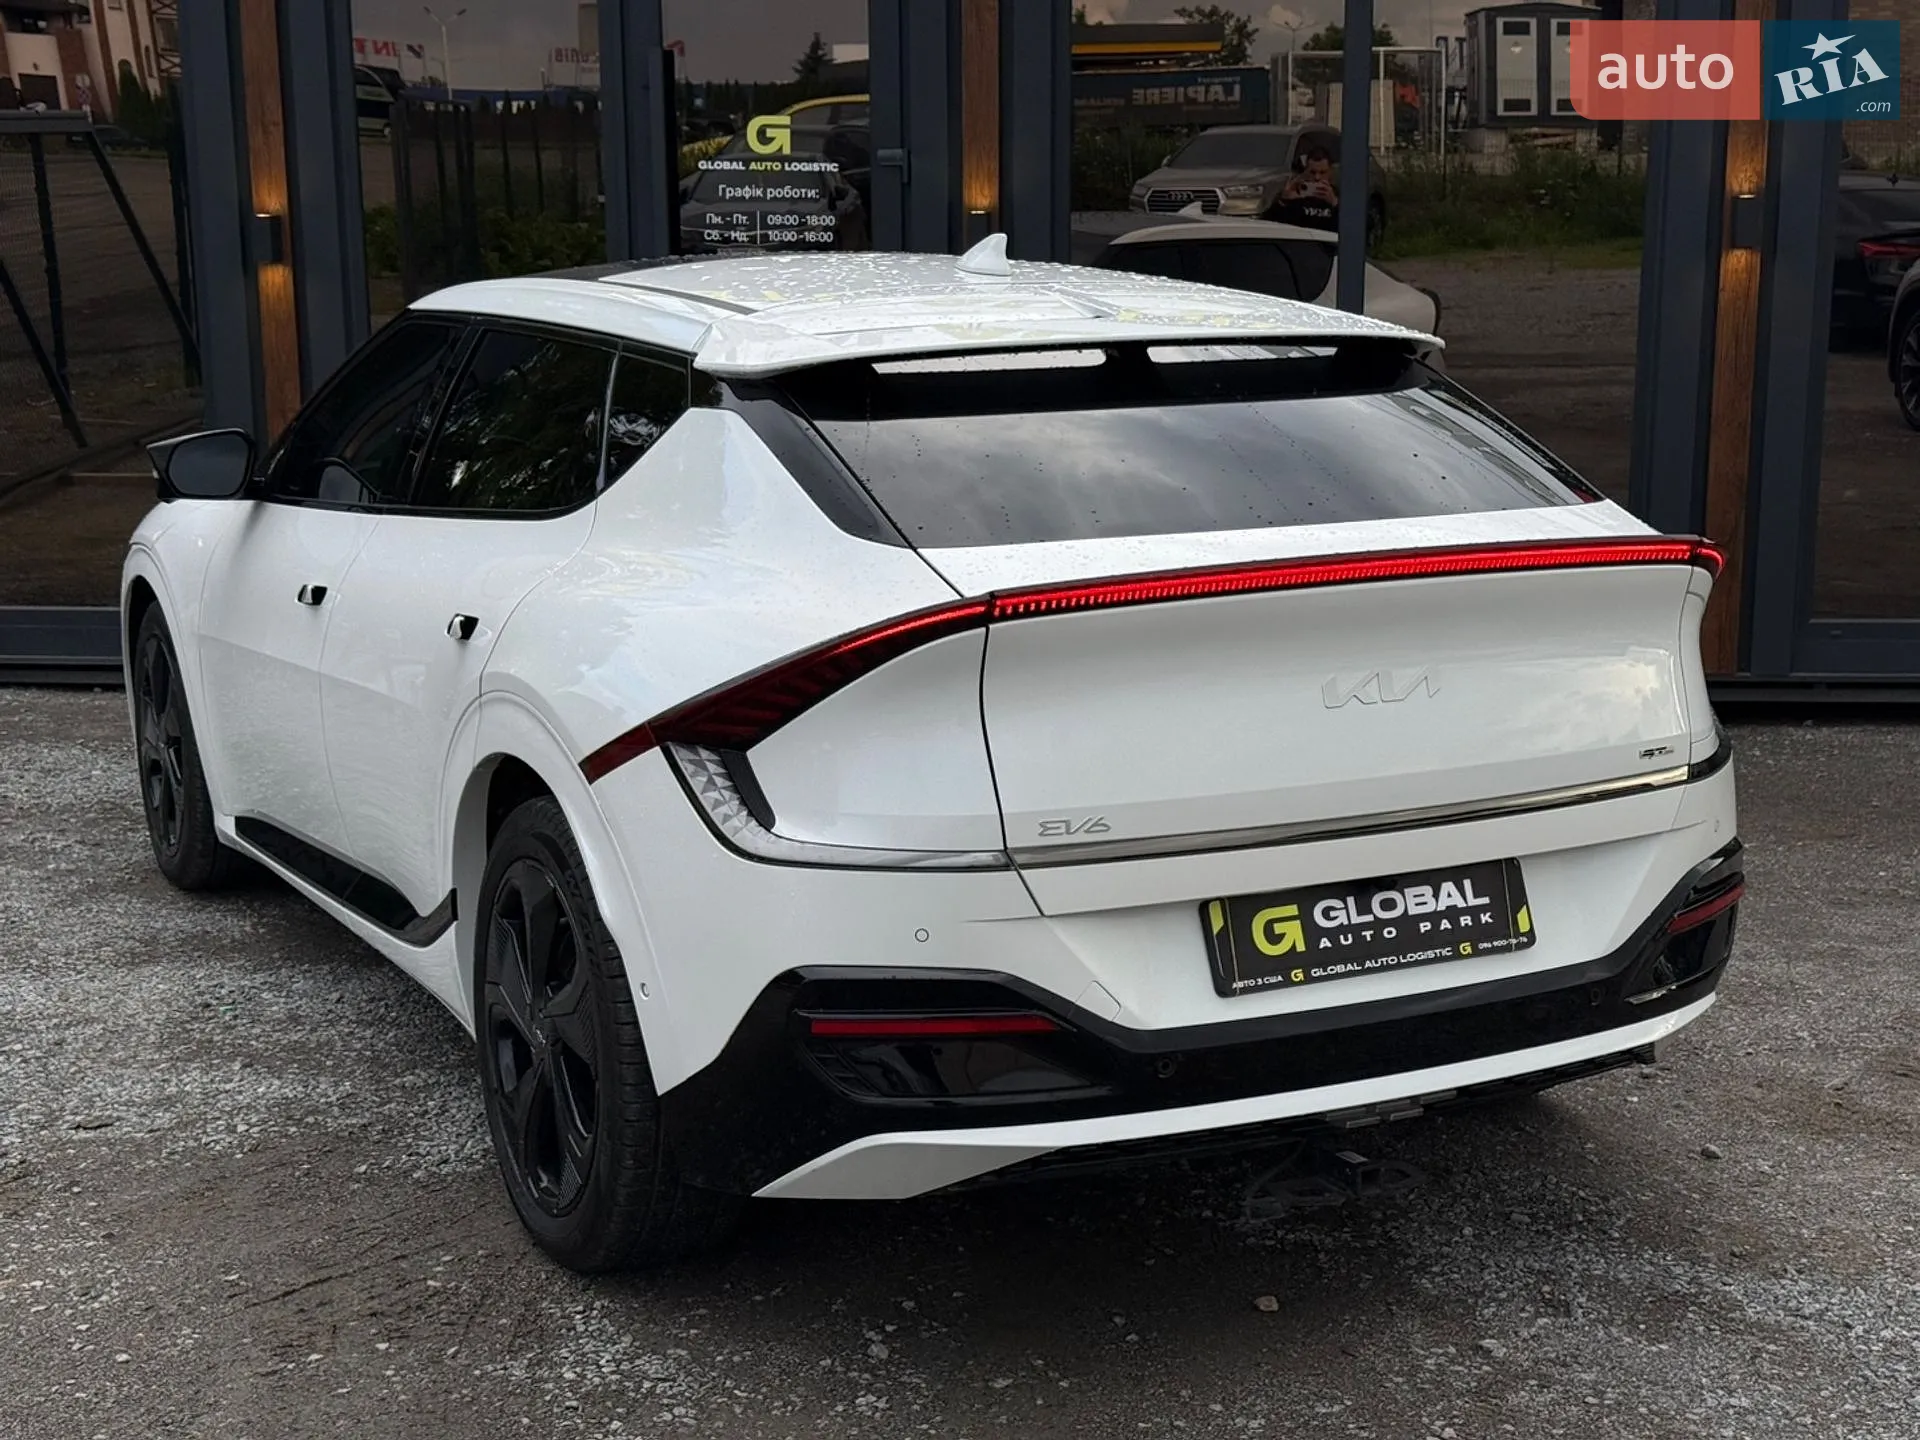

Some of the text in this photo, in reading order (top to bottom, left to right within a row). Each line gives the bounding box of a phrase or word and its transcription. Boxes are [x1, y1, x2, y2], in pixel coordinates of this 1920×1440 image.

[698, 160, 839, 172] GLOBAL AUTO LOGISTIC
[718, 184, 820, 200] Графік роботи:
[706, 213, 724, 224] Пн.
[733, 213, 750, 225] Пт.
[767, 214, 798, 225] 09:00
[704, 229, 722, 241] Сб.
[731, 230, 750, 242] Нд.
[768, 231, 797, 242] 10:00
[1038, 814, 1112, 837] EV6
[1313, 878, 1490, 929] GLOBAL
[1318, 911, 1495, 949] AUTO PARK
[1311, 946, 1453, 978] GLOBAL AUTO LOGISTIC
